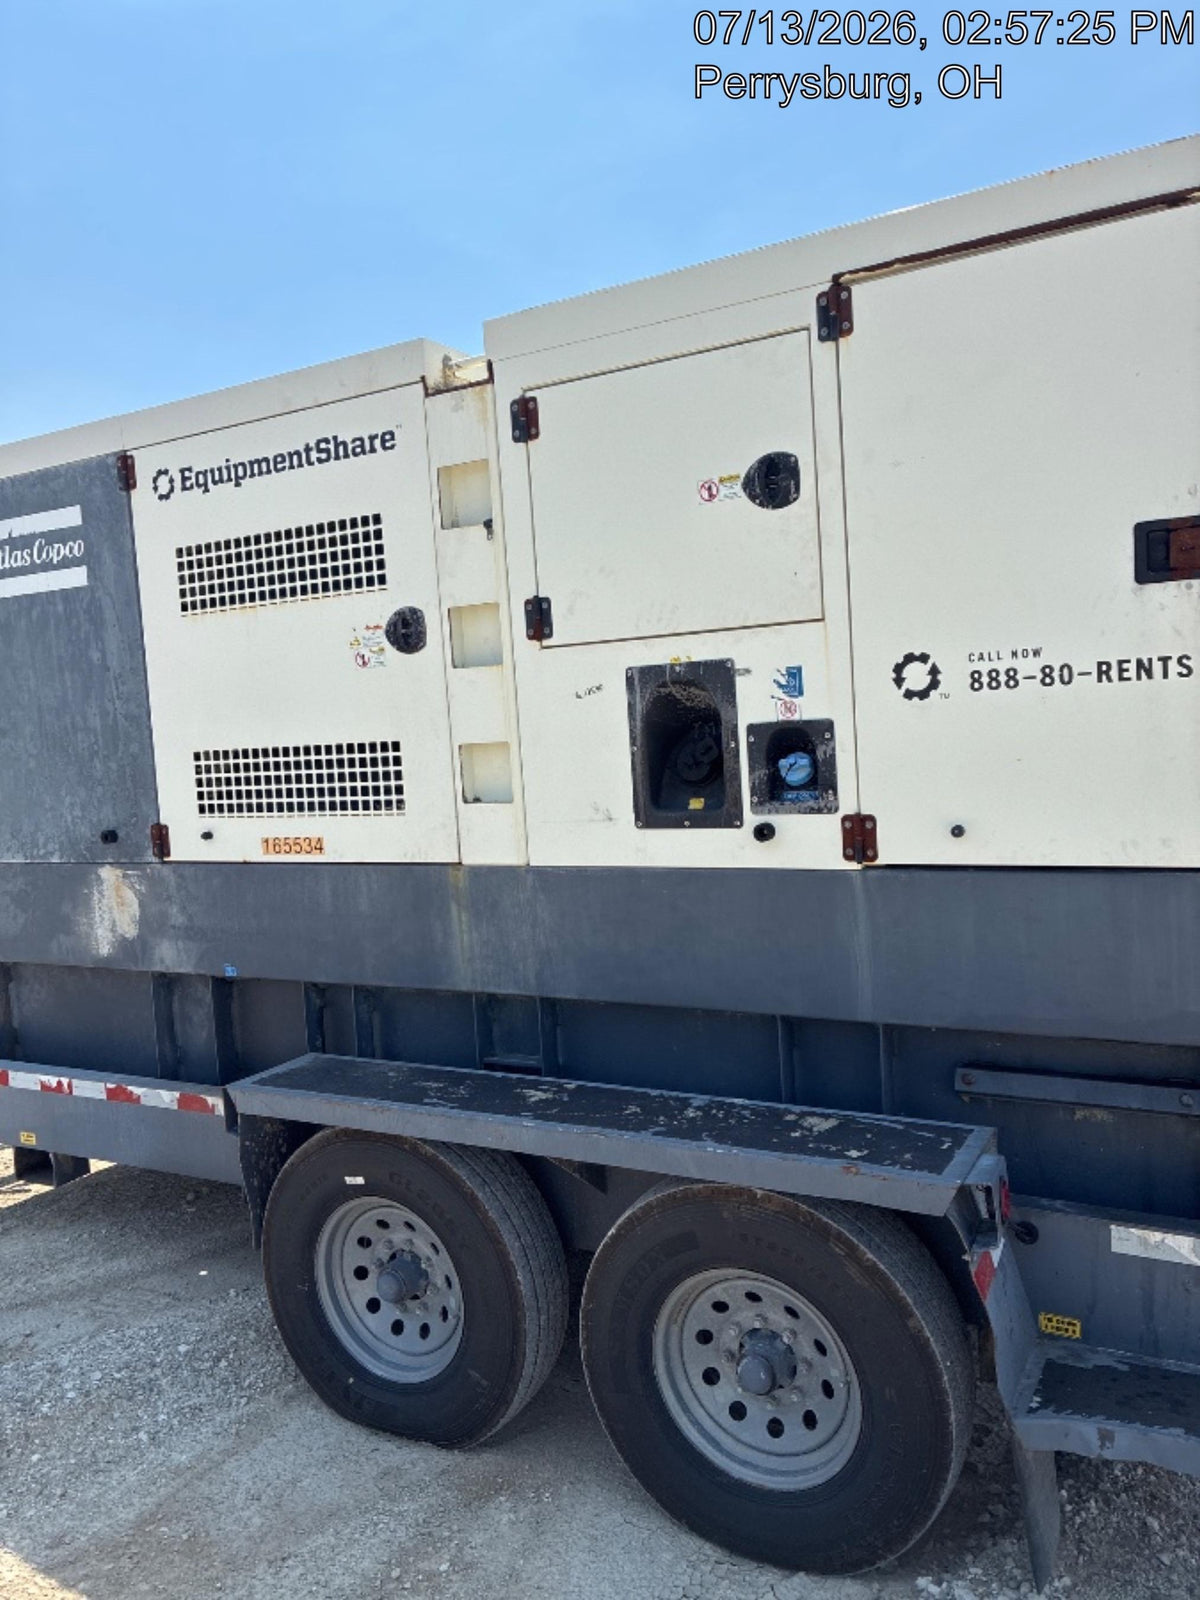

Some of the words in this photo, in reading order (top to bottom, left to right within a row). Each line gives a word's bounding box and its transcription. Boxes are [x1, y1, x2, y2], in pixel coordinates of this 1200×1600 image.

[179, 429, 397, 494] EquipmentShare
[32, 538, 85, 565] Copco
[968, 650, 1003, 663] CALL
[1011, 646, 1043, 661] NOW
[969, 654, 1194, 691] 888-80-RENTS
[262, 837, 324, 854] 165534
